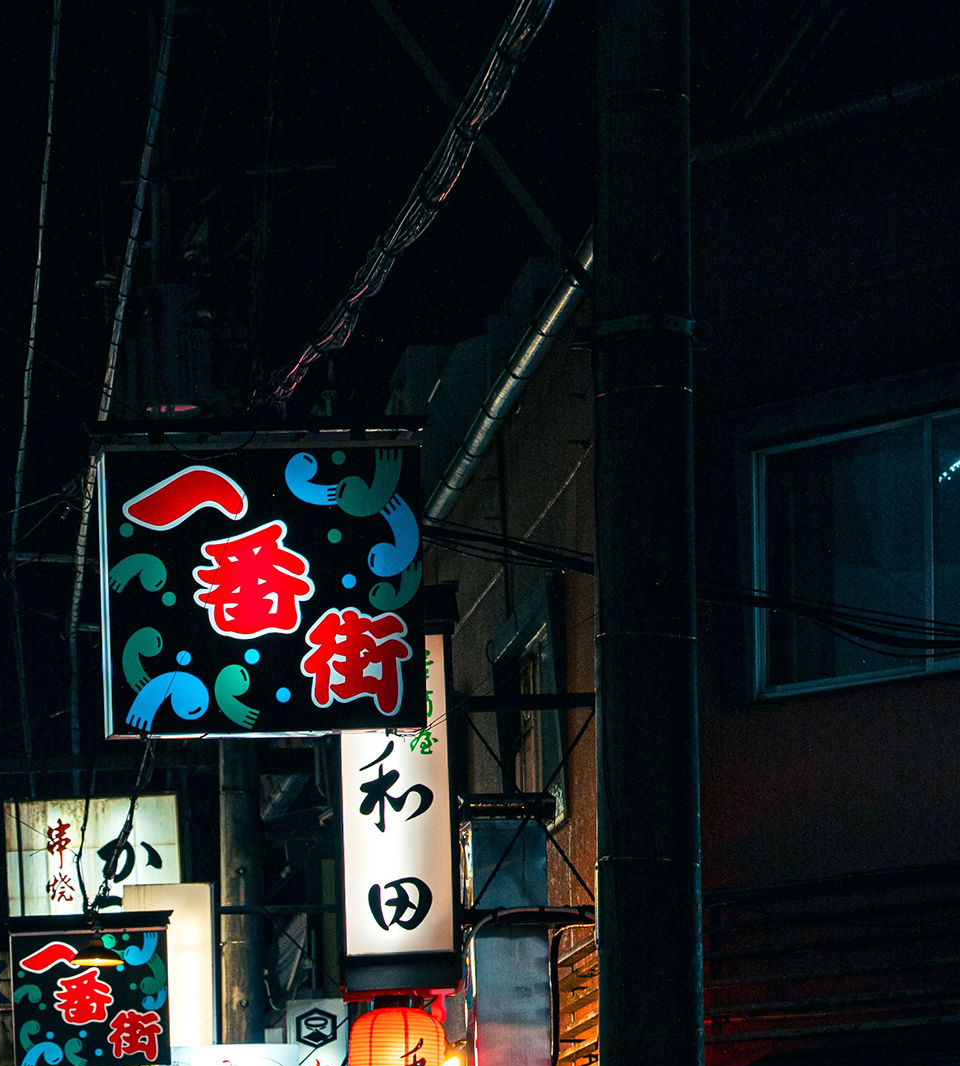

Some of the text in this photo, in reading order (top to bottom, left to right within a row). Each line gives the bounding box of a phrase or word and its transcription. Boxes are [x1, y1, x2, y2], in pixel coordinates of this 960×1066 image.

[123, 465, 413, 716] 一番街
[358, 741, 434, 931] 和田
[19, 940, 164, 1062] 一番街
